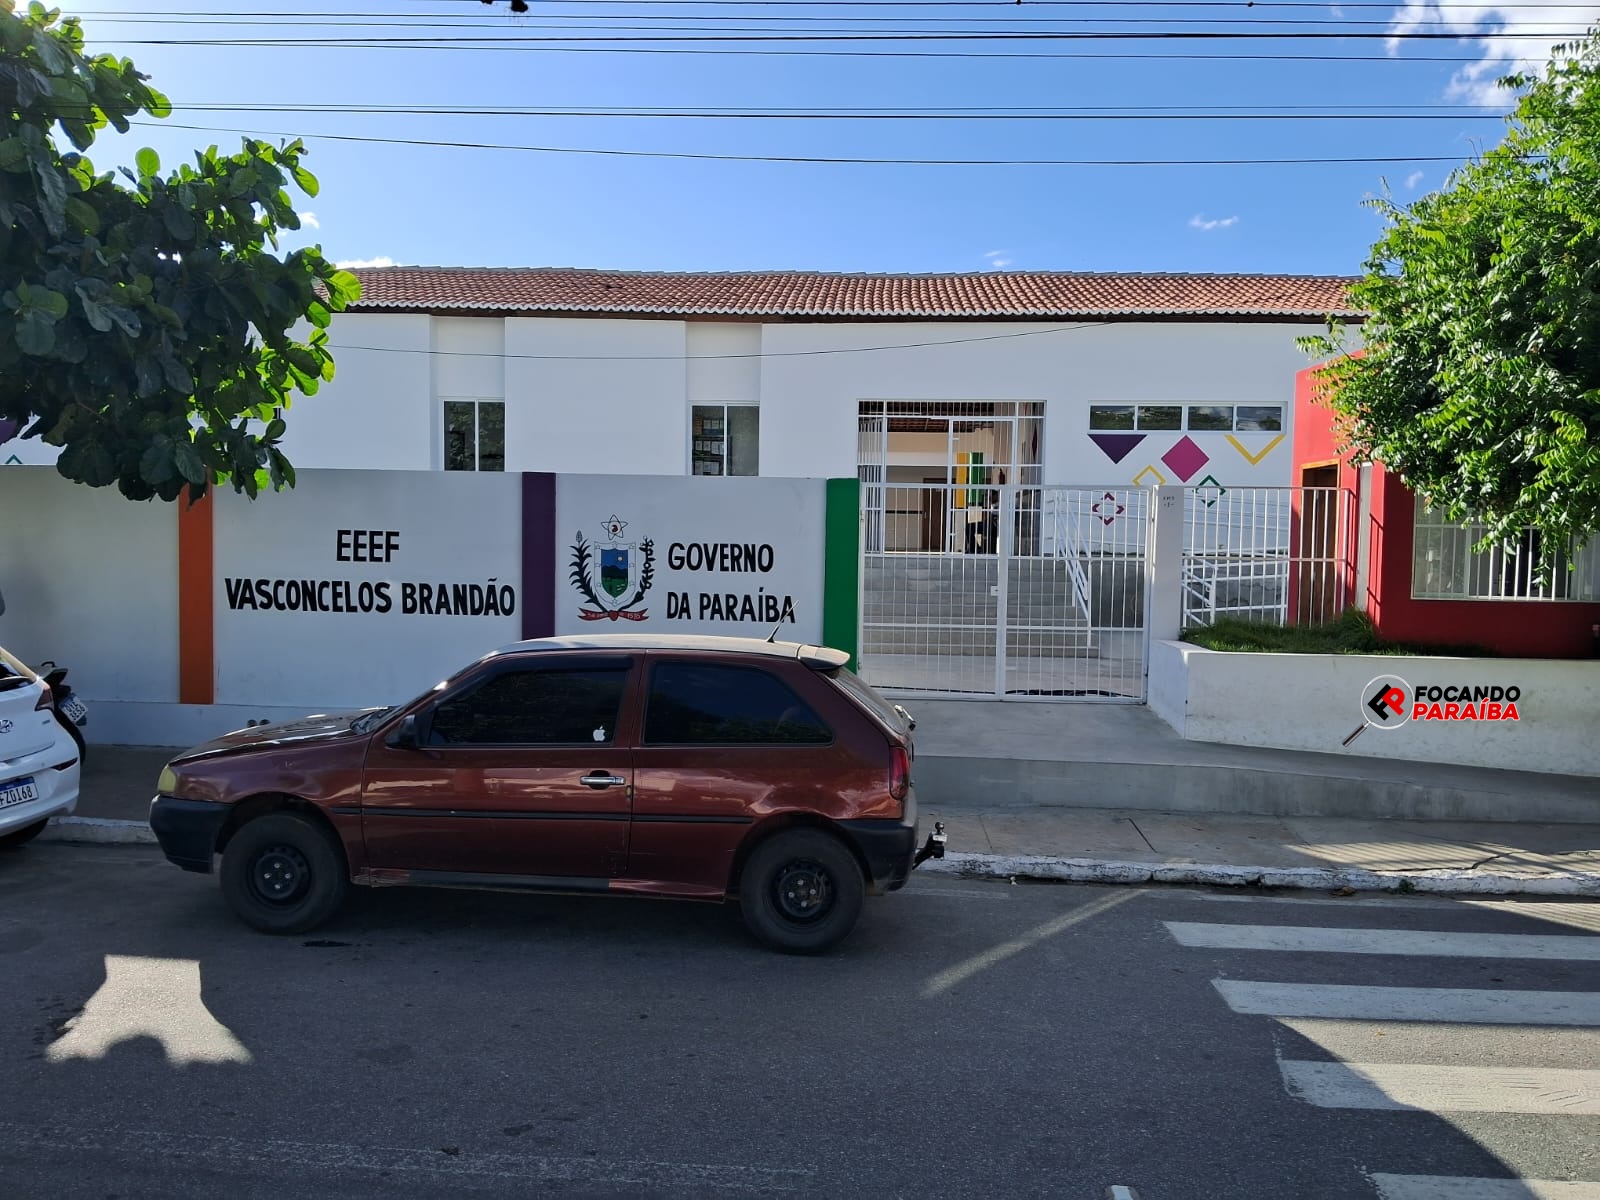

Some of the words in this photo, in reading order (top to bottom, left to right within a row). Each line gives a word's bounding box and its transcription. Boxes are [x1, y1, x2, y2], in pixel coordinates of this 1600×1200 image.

[337, 530, 400, 563] EEEF
[667, 542, 774, 573] GOVERNO
[225, 578, 393, 614] VASCONCELOS
[402, 577, 515, 617] BRANDÃO
[666, 591, 692, 620] DA
[699, 586, 796, 624] PARAÍBA
